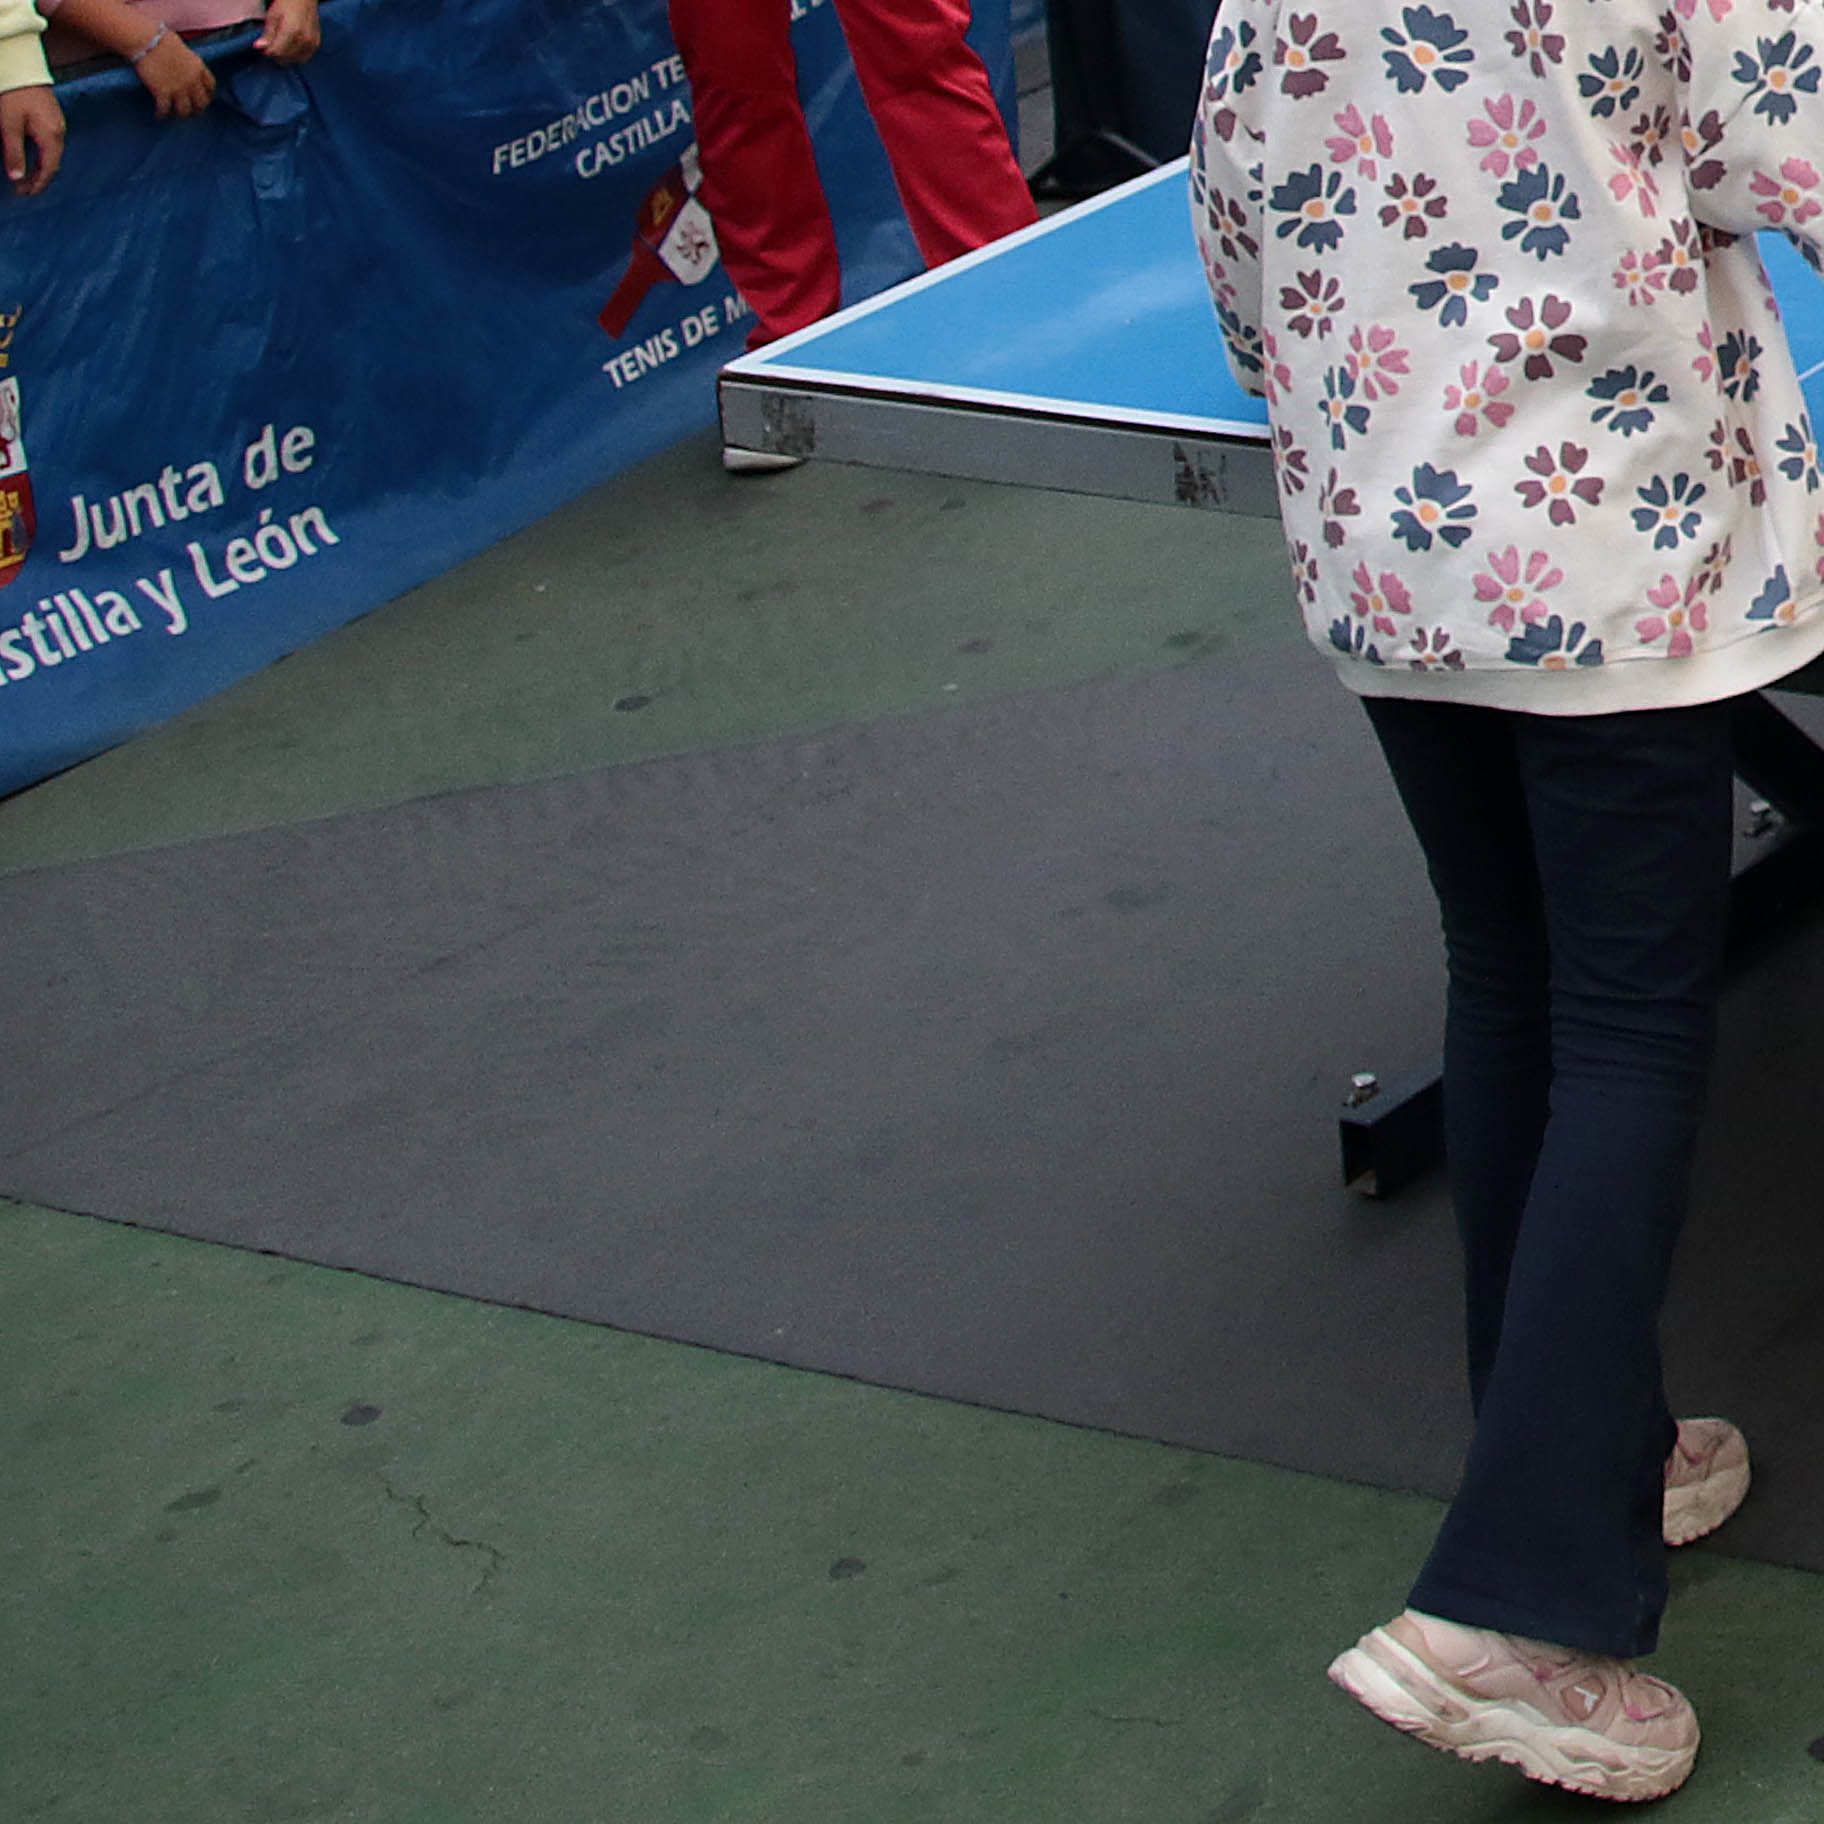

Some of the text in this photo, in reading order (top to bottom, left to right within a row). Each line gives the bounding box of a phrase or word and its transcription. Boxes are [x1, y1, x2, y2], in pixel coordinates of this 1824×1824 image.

[493, 72, 650, 175] FEDERACION
[575, 99, 692, 179] CASTILLA
[602, 328, 680, 389] TENIS
[680, 305, 720, 347] DE
[58, 423, 315, 564] Junta de
[0, 507, 341, 686] stilla y León
